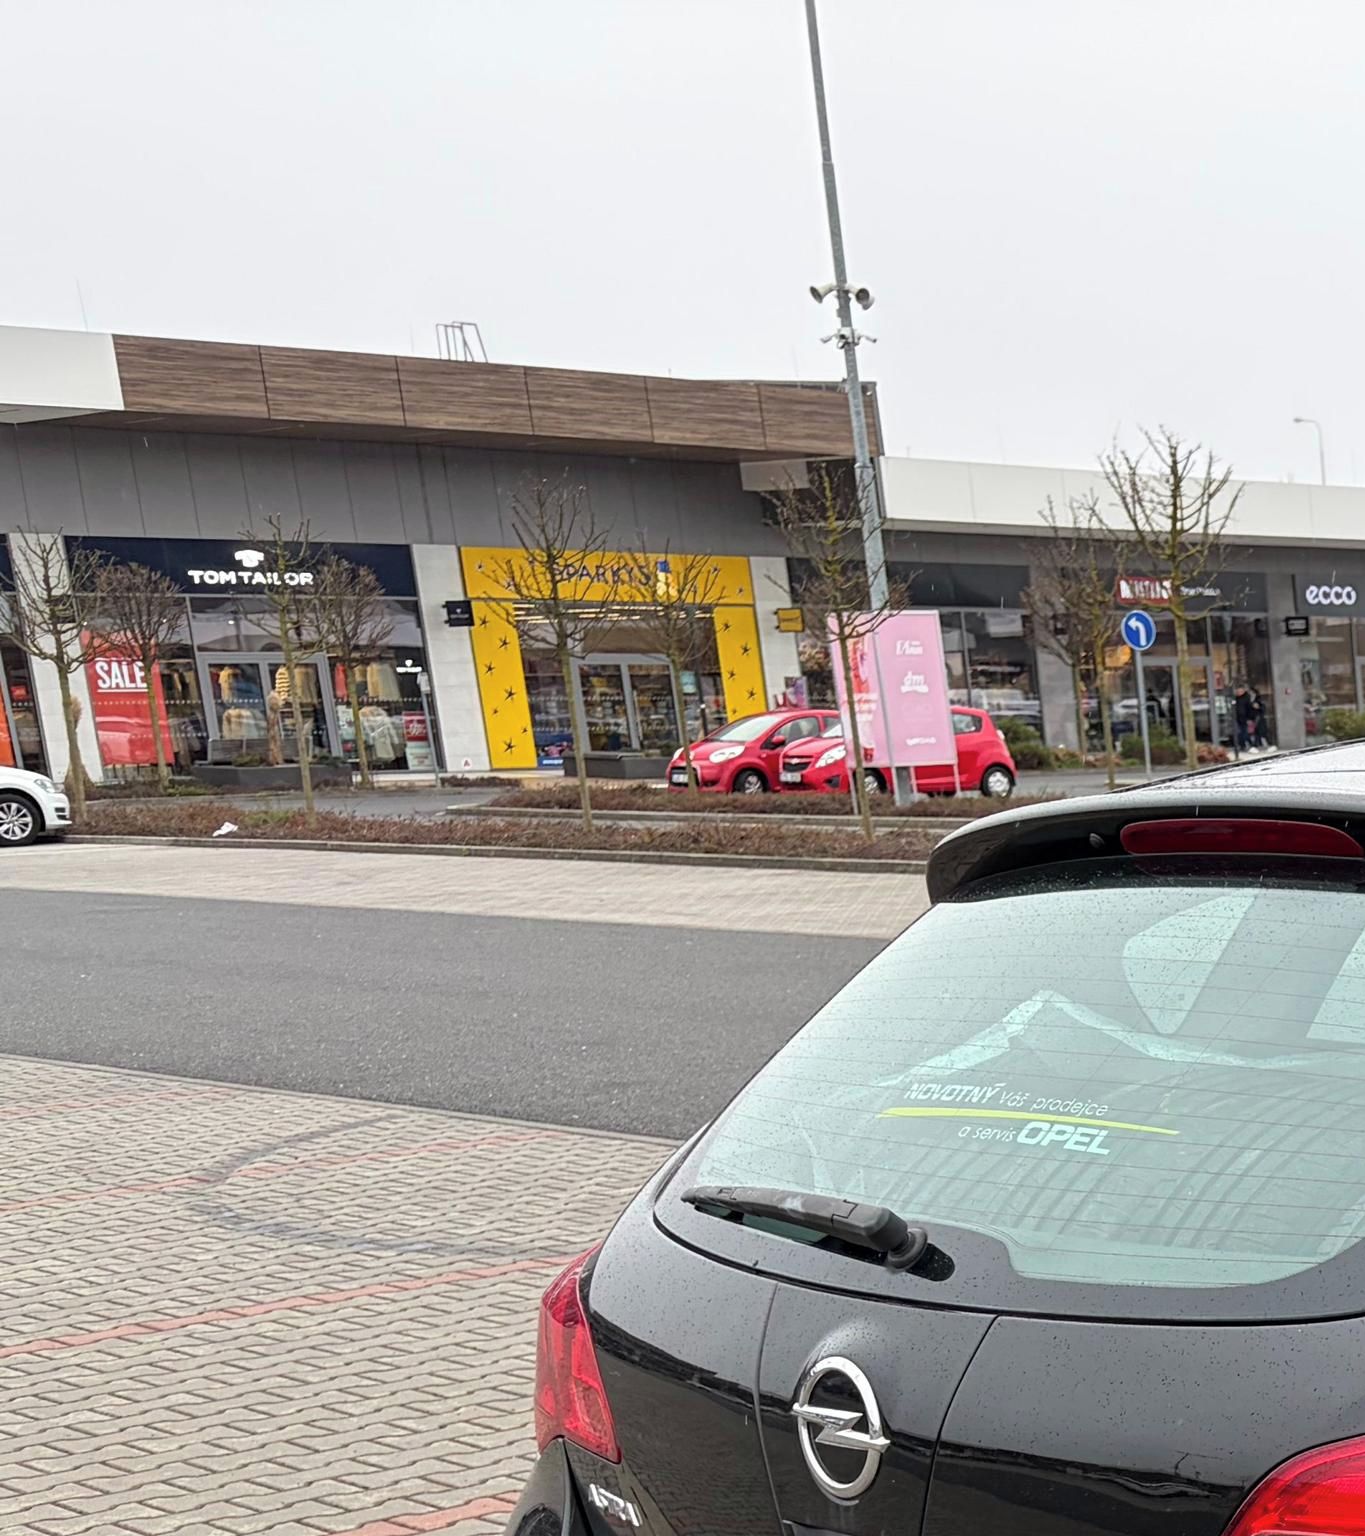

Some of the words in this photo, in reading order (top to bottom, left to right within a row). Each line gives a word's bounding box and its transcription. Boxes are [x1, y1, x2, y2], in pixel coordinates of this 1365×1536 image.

[187, 569, 238, 585] TOM
[238, 571, 314, 586] TAILOR
[1306, 585, 1357, 605] ecco
[96, 660, 148, 689] SALE
[904, 1083, 1007, 1104] NOVOTNÝ
[1030, 1097, 1109, 1117] prodejce
[957, 1127, 971, 1138] a
[972, 1126, 1017, 1143] servis
[1016, 1121, 1111, 1156] OPEL
